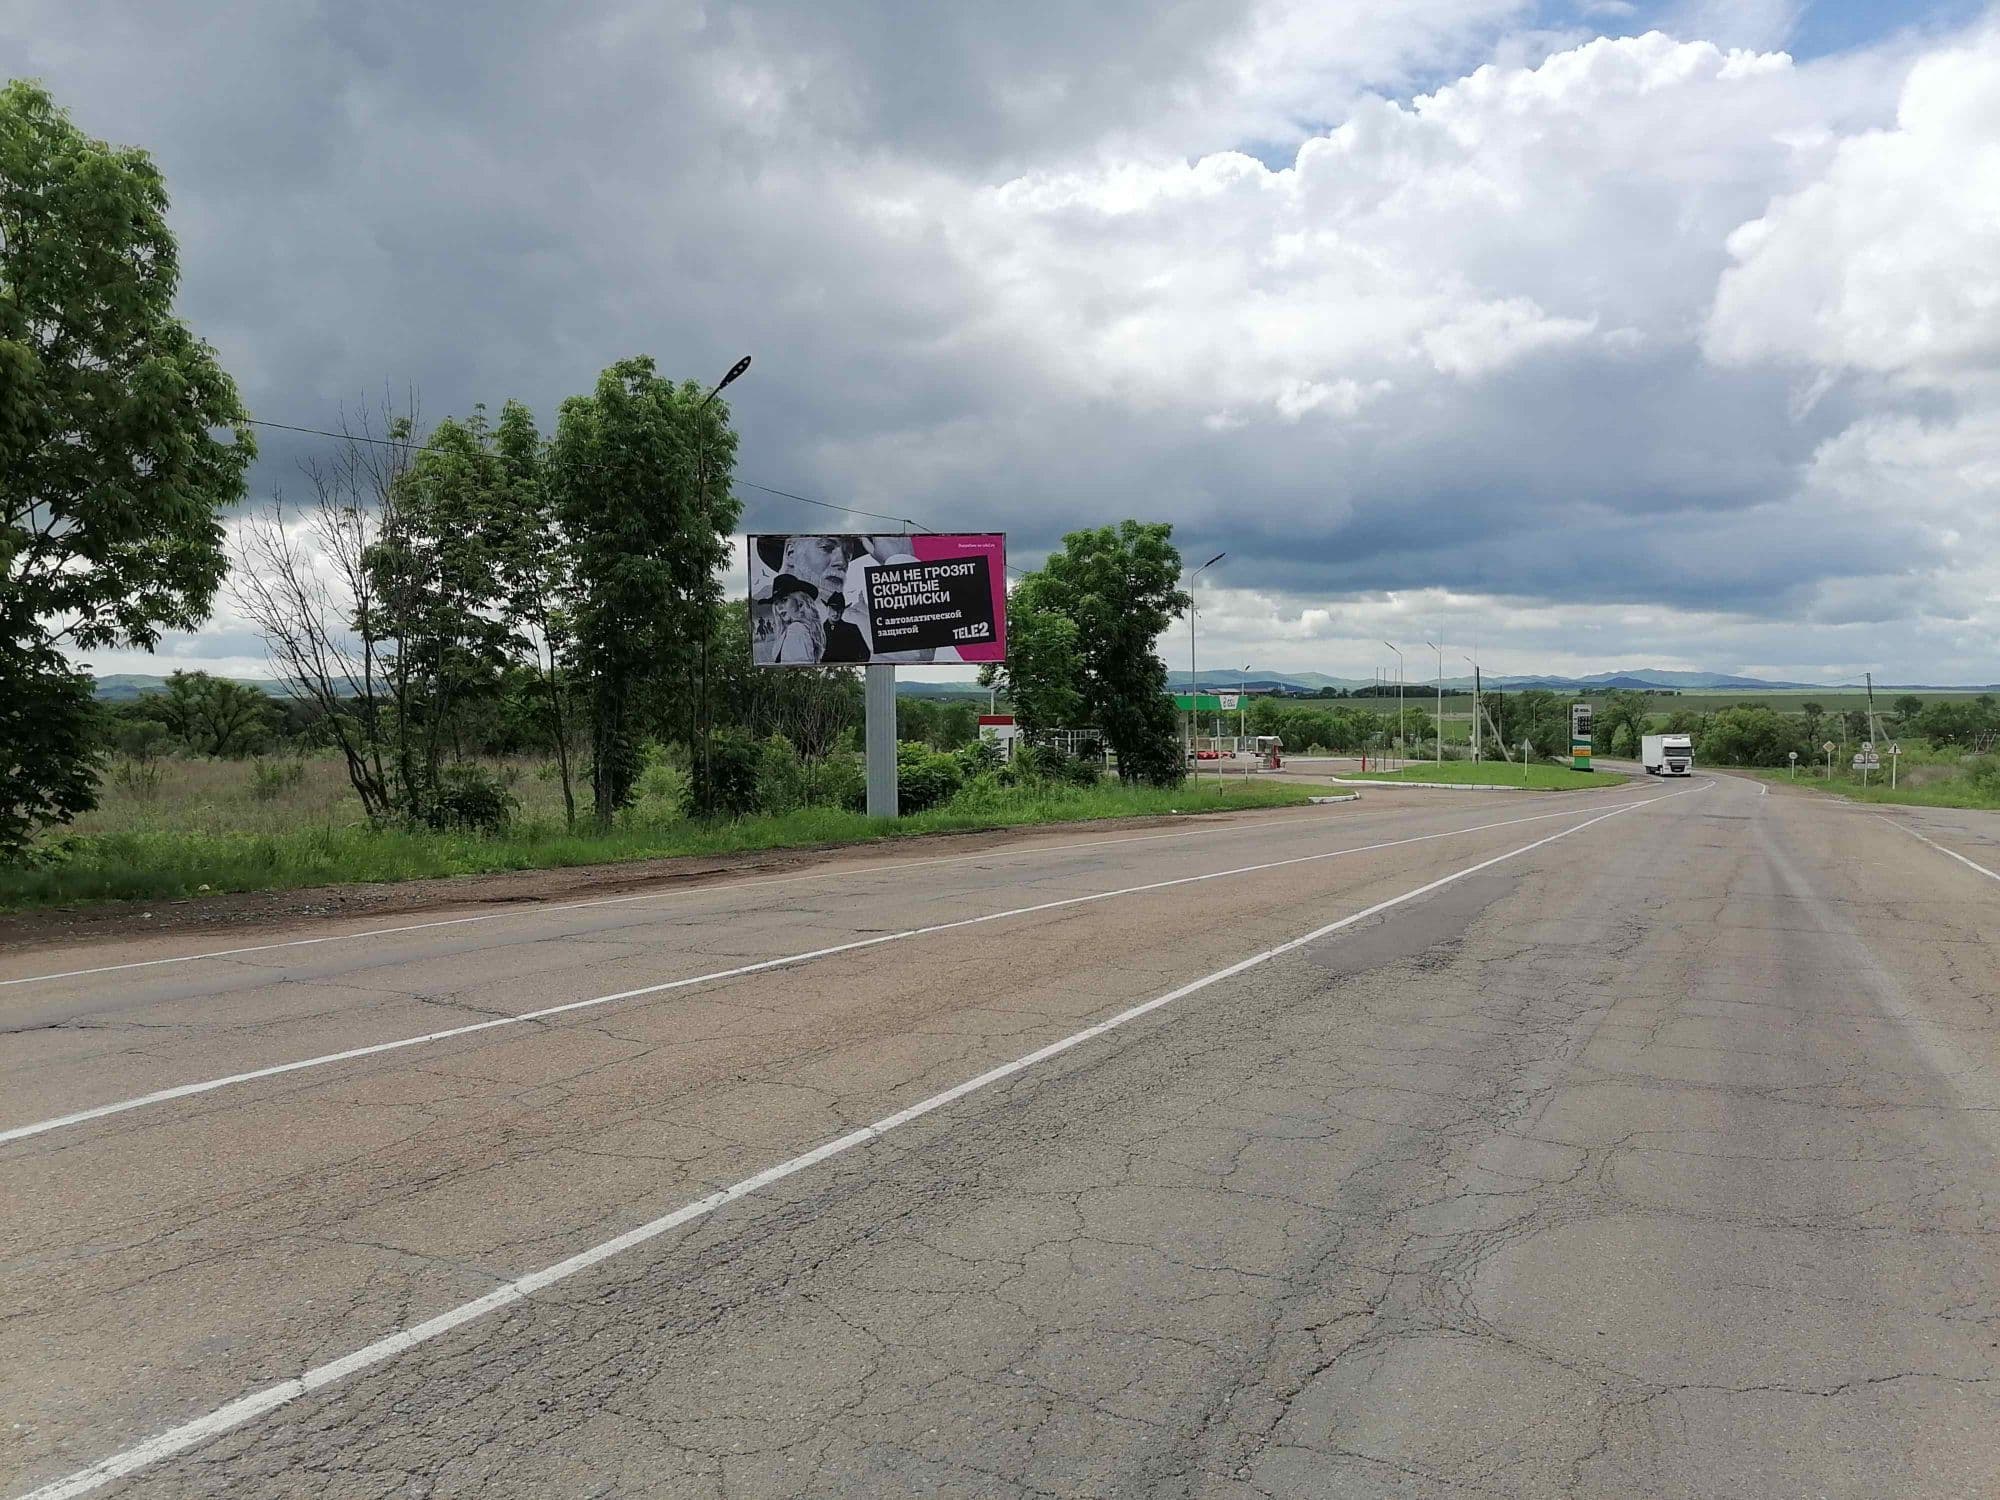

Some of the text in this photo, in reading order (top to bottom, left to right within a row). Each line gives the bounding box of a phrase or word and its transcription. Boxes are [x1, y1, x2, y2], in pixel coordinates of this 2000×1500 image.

[871, 563, 976, 584] ВАМ НЕ ГРОЗЯТ
[872, 580, 940, 597] СКРЫТЫЕ
[874, 591, 950, 610] ПОДПИСКИ
[876, 609, 962, 626] С автоматической
[877, 625, 919, 637] защитой
[952, 621, 989, 640] TELE2
